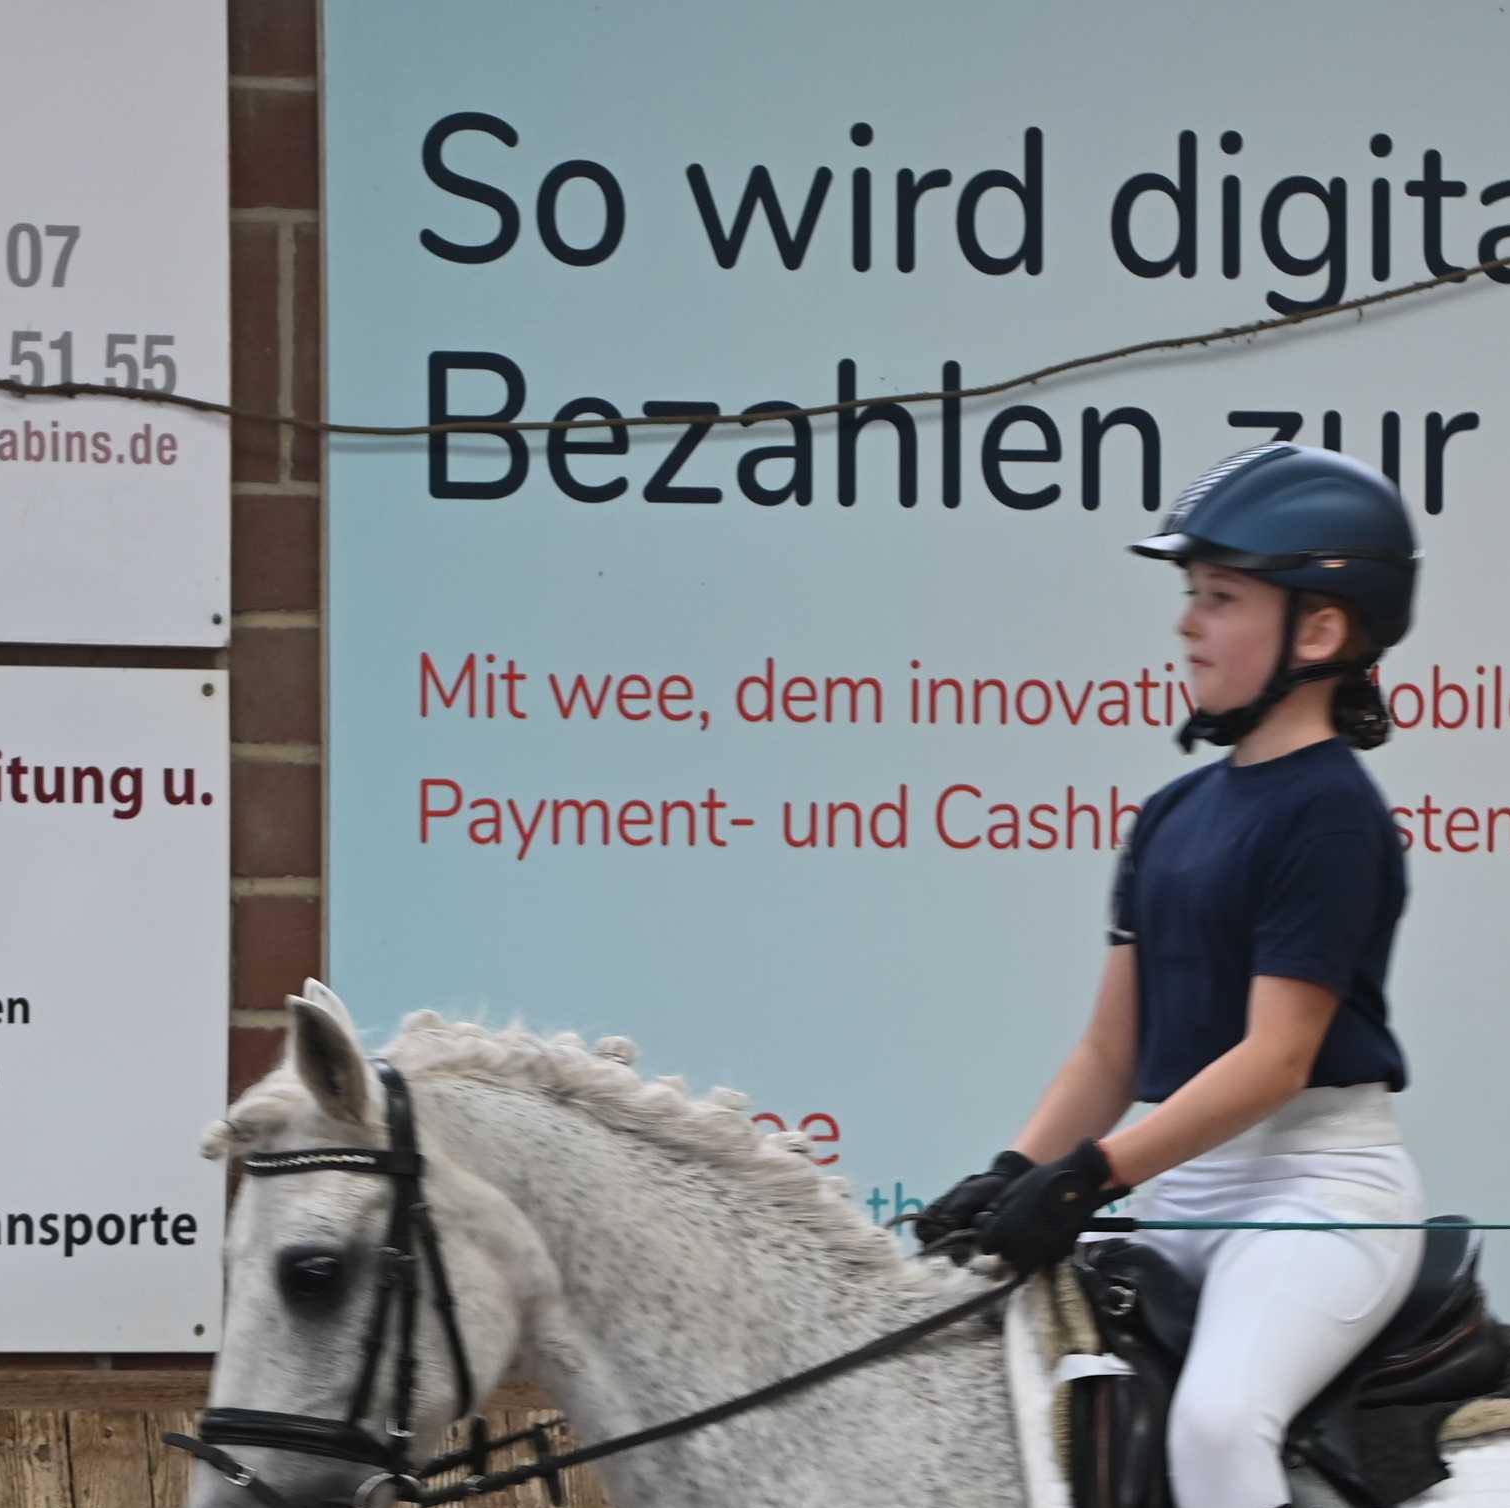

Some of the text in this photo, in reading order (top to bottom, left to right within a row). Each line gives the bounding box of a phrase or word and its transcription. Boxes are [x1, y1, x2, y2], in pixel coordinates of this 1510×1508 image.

[419, 111, 626, 267] So
[686, 122, 1043, 277] wird
[5, 222, 81, 289] 07
[8, 330, 76, 394] 51
[103, 333, 179, 397] 55
[427, 350, 1162, 513] Bezahlen
[419, 652, 527, 720] Mit
[548, 671, 712, 732] wee,
[735, 657, 883, 724] dem
[161, 766, 215, 808] u.
[419, 777, 755, 862] Payment-
[783, 784, 909, 850] und
